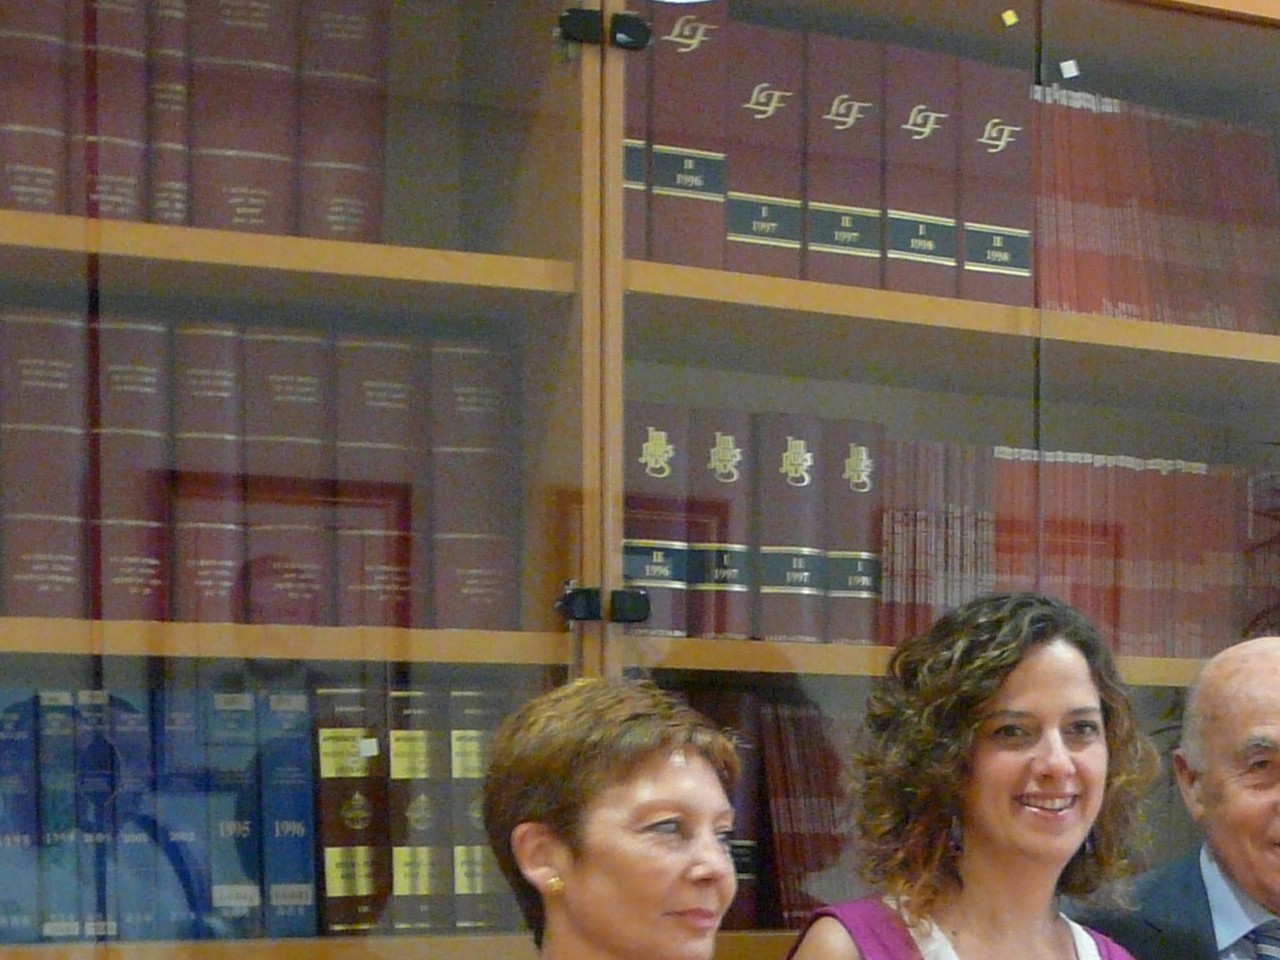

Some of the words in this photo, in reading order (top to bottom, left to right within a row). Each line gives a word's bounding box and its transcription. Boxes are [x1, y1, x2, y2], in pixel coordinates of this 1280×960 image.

[645, 565, 670, 577] 1996
[714, 568, 739, 580] 1997
[786, 571, 811, 583] 1997
[218, 821, 251, 838] 1995
[274, 821, 305, 838] 1996
